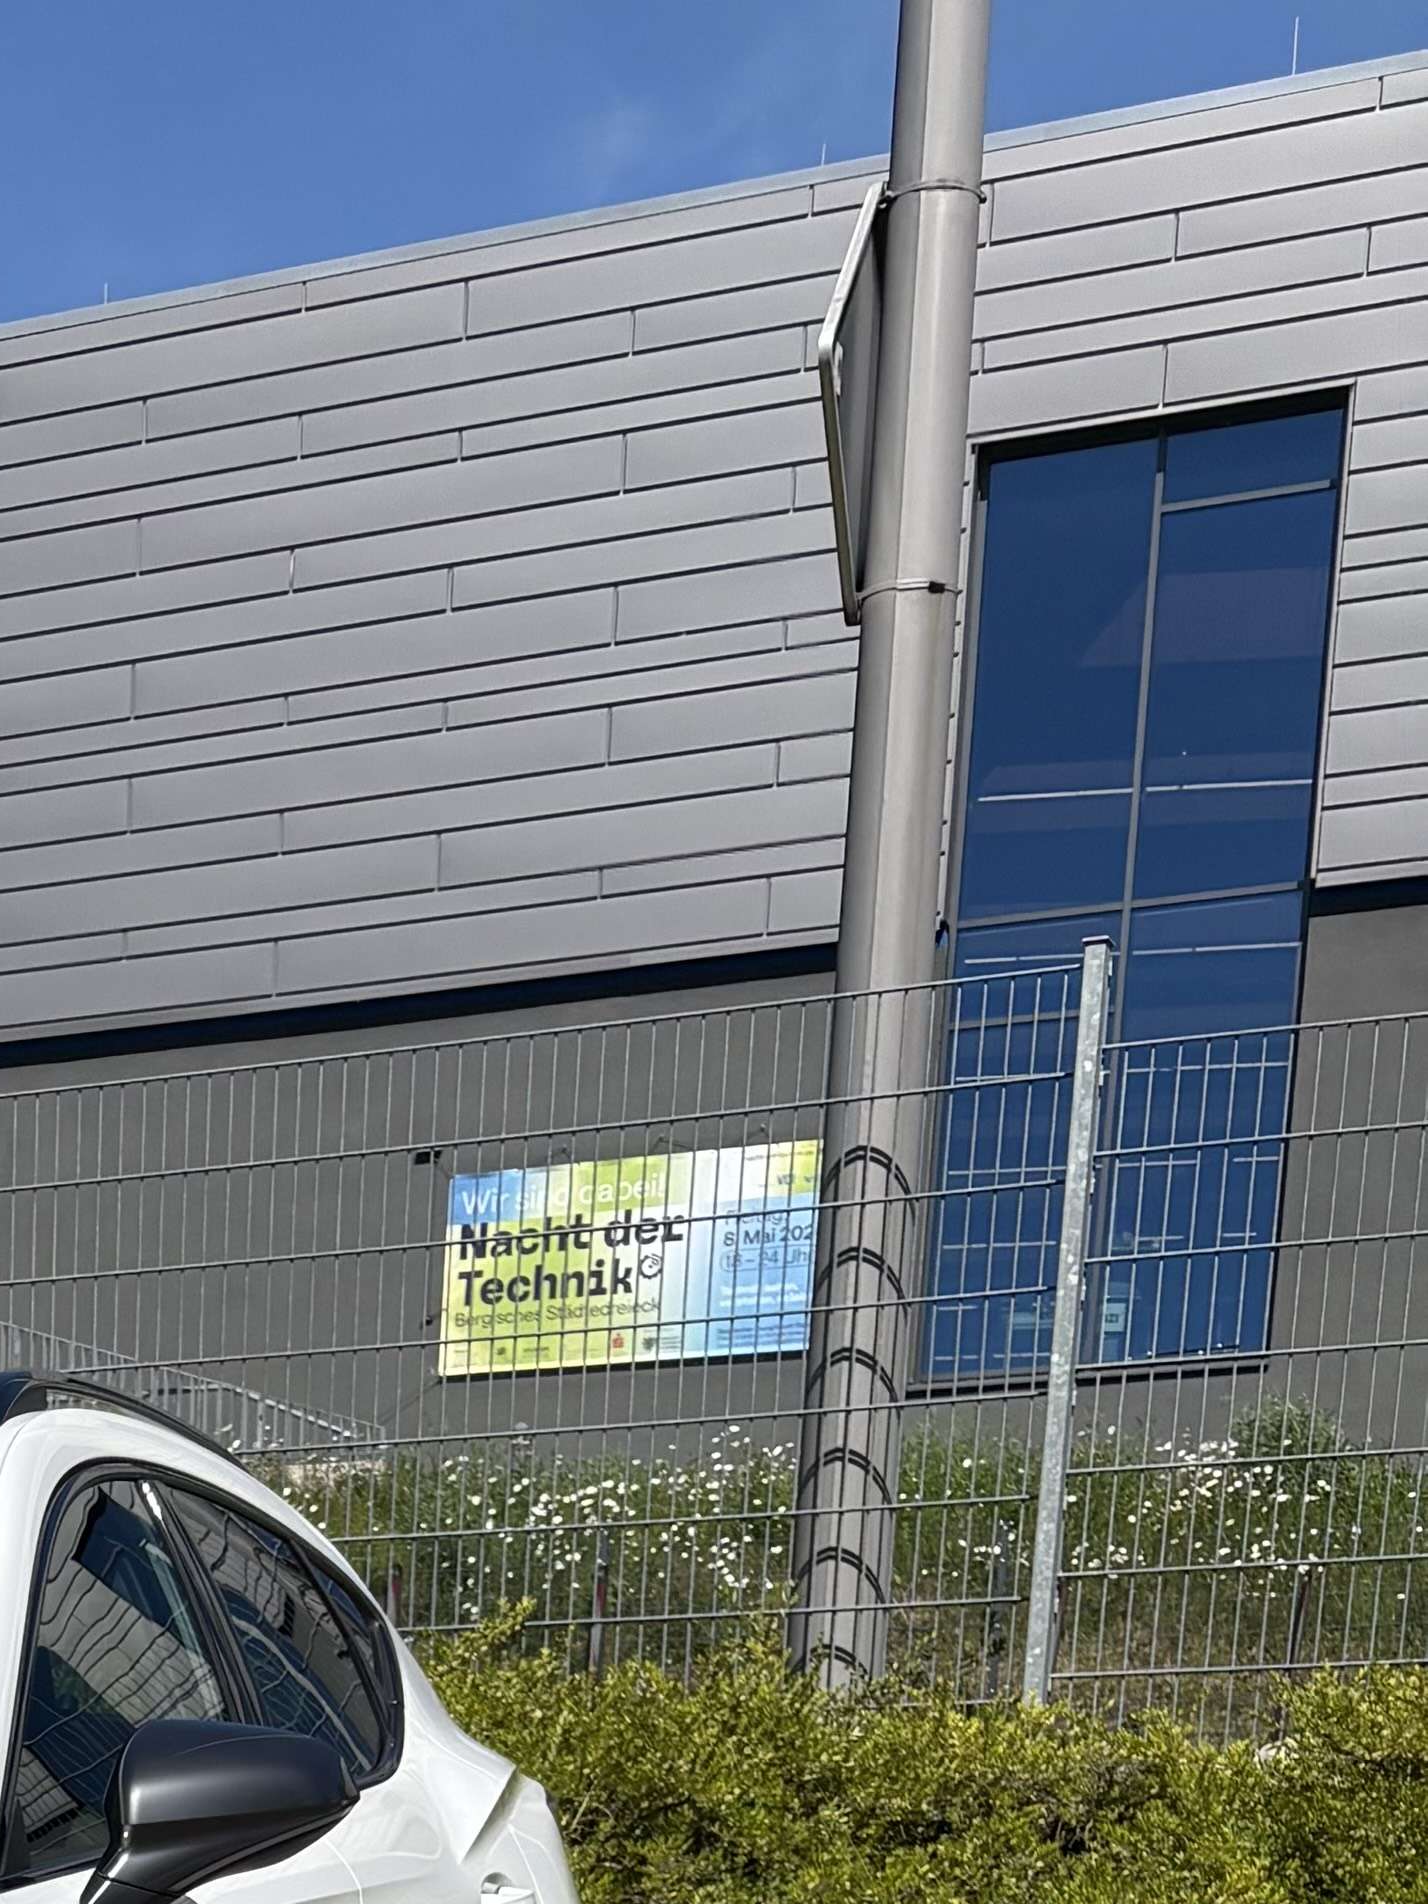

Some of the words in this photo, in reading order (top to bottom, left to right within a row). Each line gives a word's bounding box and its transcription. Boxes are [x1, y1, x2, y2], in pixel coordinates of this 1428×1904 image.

[461, 1187, 509, 1215] Wir
[579, 1172, 667, 1205] dabei!
[459, 1213, 592, 1260] Nacht
[604, 1208, 685, 1248] der
[743, 1228, 776, 1245] Mai
[780, 1224, 813, 1242] 202
[458, 1258, 634, 1307] Technik
